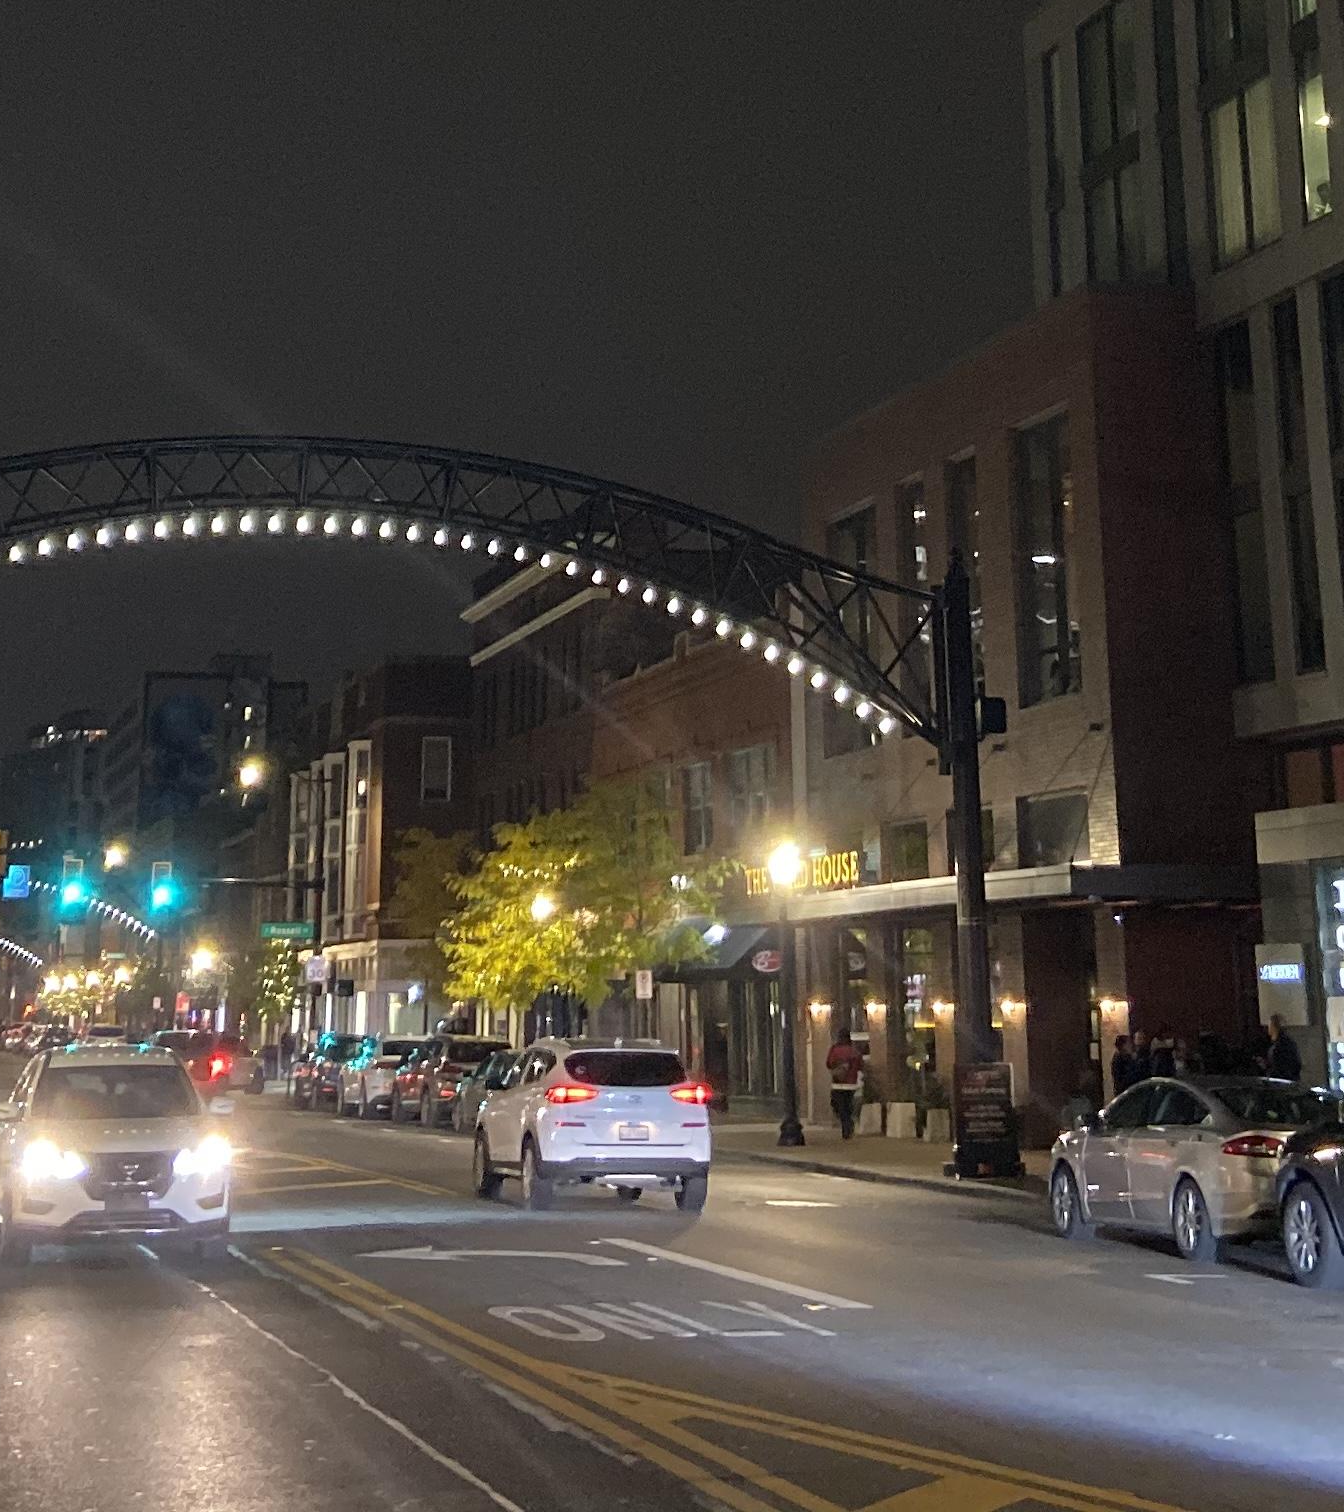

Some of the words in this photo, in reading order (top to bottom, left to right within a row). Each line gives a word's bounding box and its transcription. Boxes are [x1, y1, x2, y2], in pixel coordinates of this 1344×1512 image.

[745, 867, 769, 895] THE
[812, 851, 859, 887] HOUSE
[309, 968, 323, 978] 30
[488, 1300, 837, 1342] ONLY
